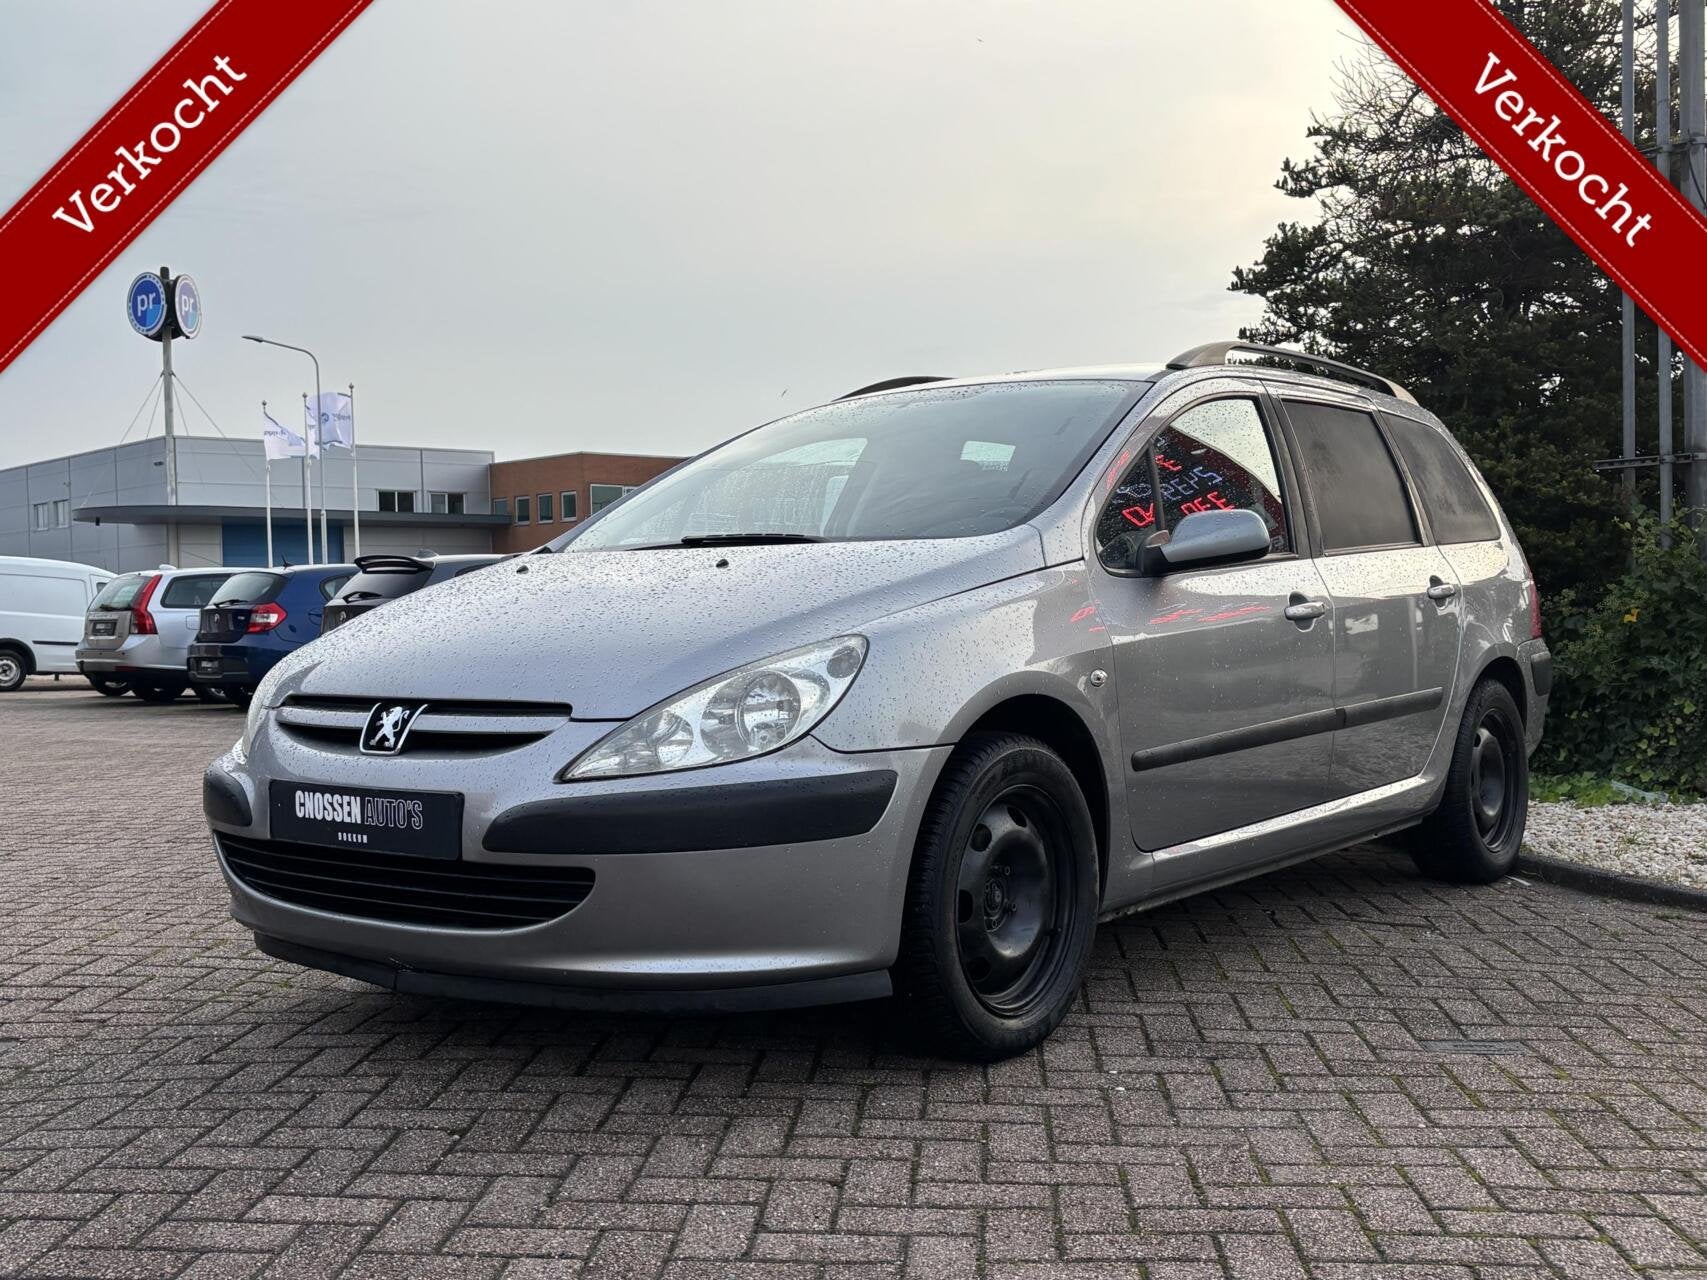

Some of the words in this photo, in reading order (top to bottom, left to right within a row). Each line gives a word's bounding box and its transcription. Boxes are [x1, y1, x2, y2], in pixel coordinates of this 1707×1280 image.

[137, 292, 156, 316] pr
[181, 294, 195, 315] pr
[295, 790, 362, 824] CNOSSEN
[364, 796, 424, 830] AUTO'S
